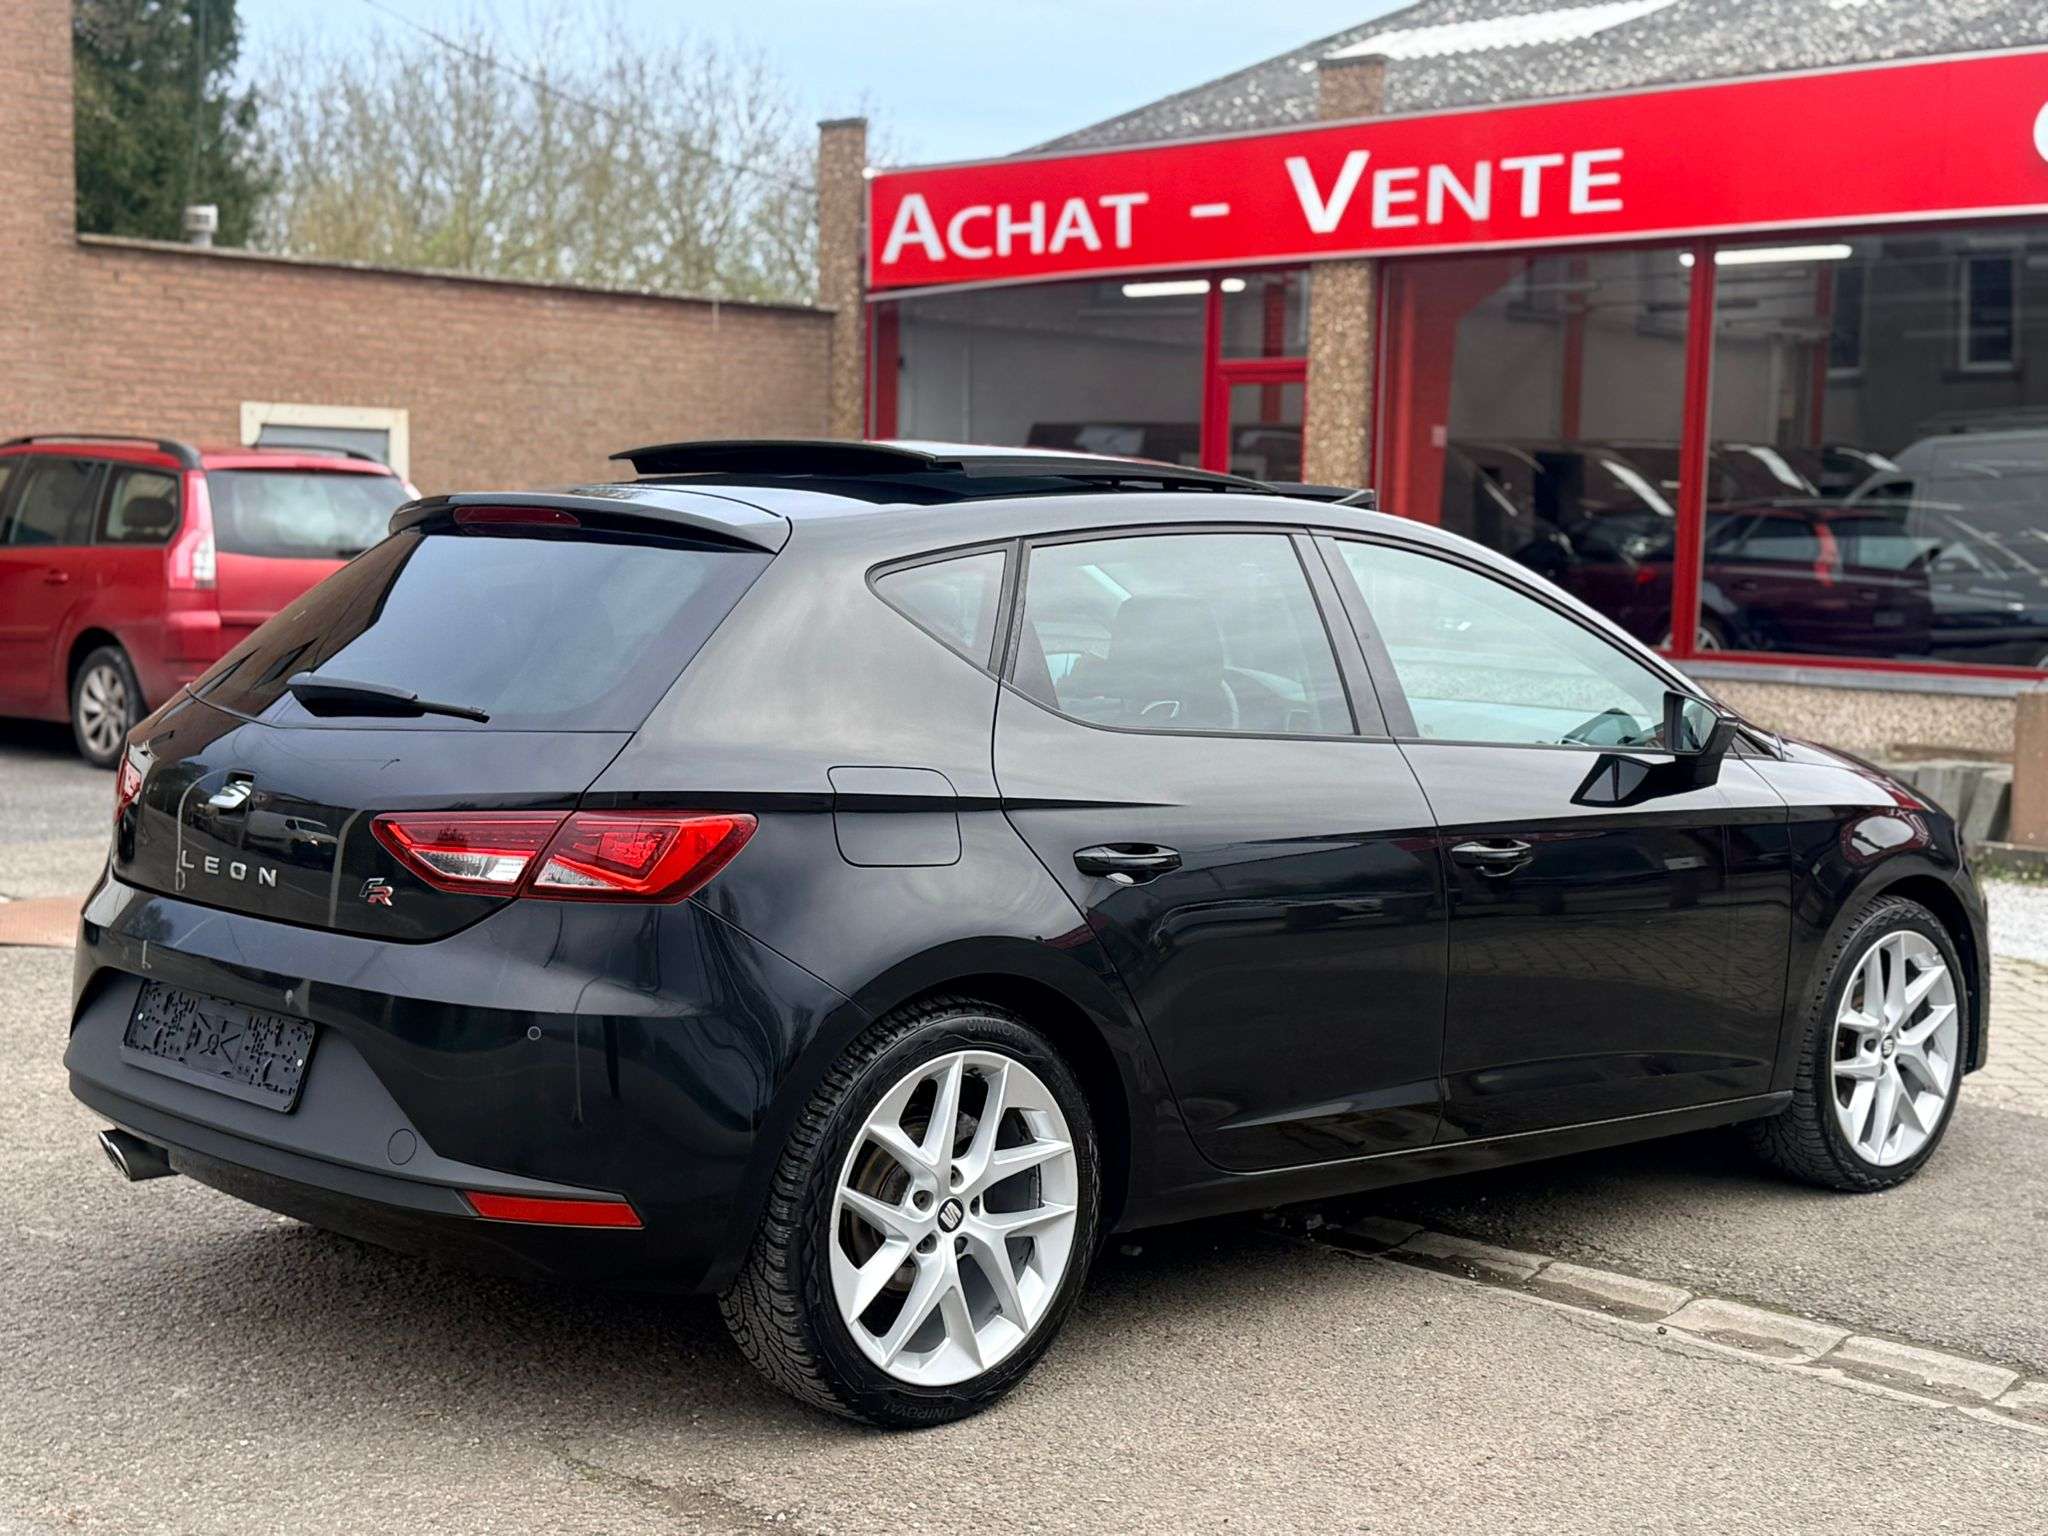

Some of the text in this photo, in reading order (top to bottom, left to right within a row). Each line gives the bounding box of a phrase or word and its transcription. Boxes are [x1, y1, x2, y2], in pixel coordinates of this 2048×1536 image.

[882, 148, 1624, 264] ACHAT - VENTE
[181, 850, 277, 887] LEON
[359, 877, 394, 907] FR
